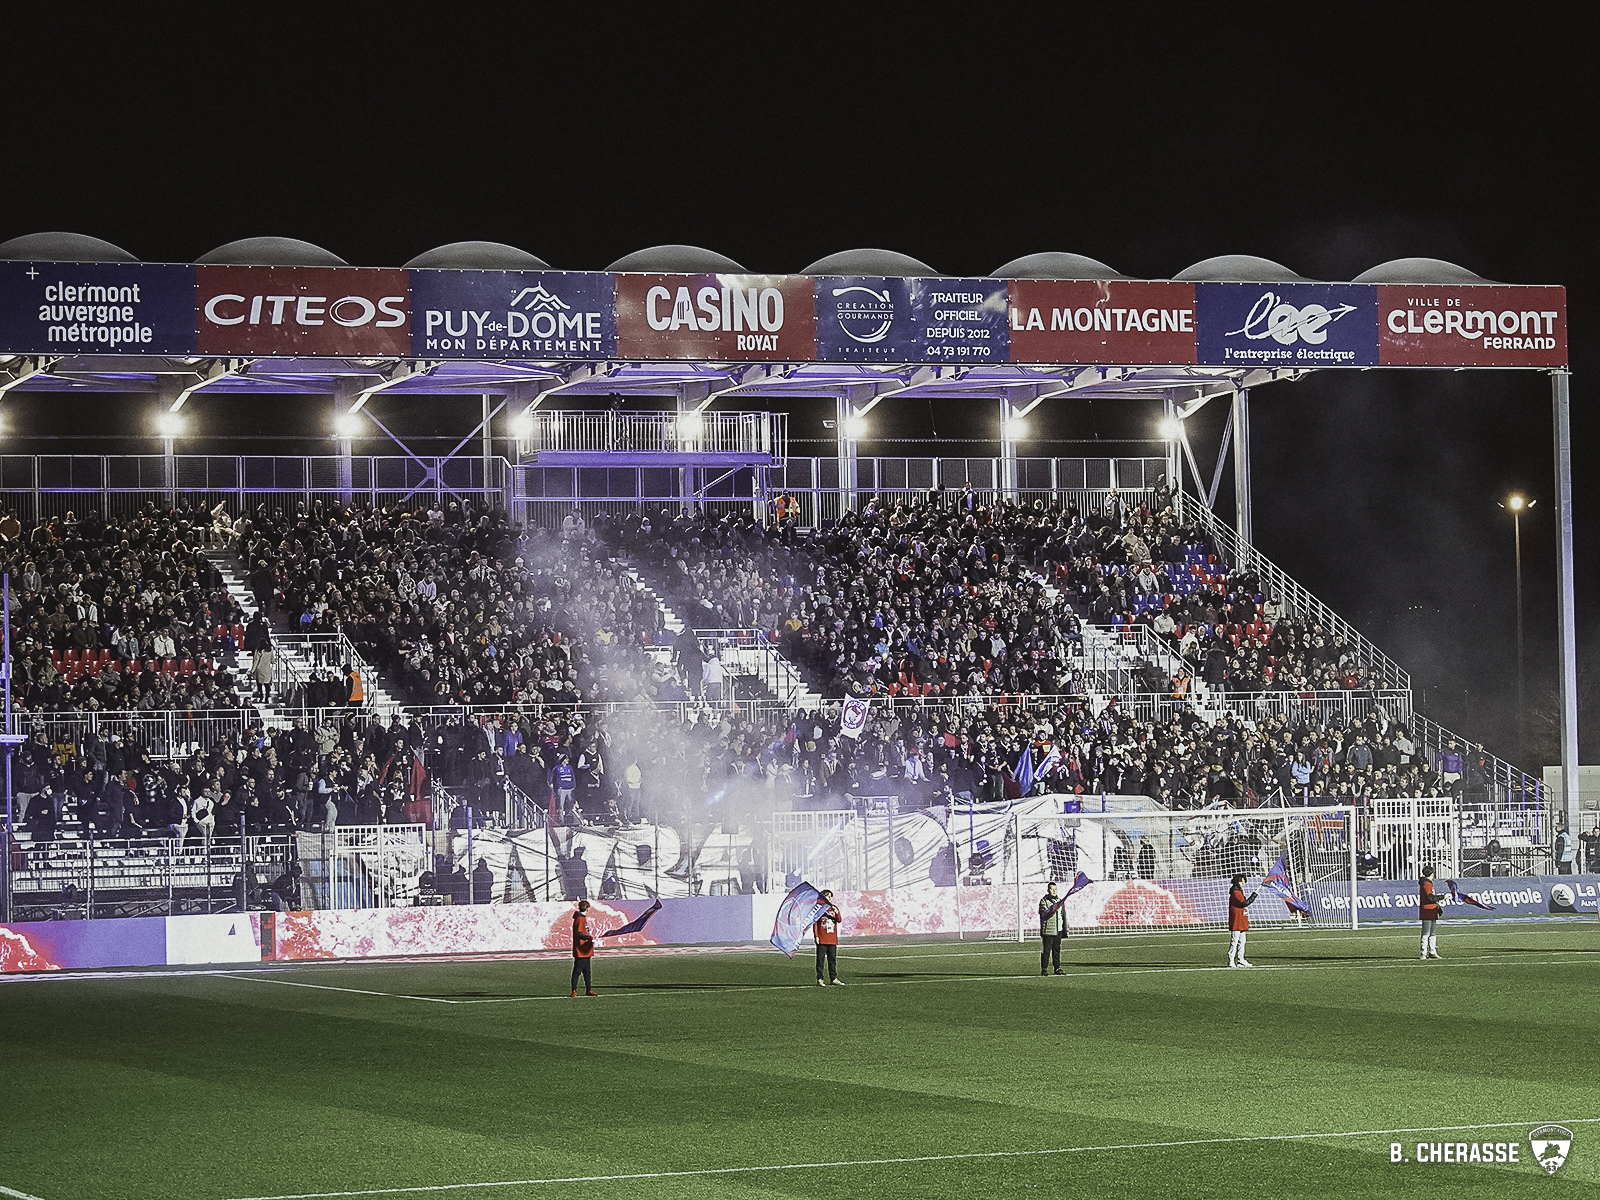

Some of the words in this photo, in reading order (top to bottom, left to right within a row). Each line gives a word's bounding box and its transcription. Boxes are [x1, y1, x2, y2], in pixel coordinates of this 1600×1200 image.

[45, 281, 141, 303] clermont
[931, 292, 984, 304] TRAITEUR
[646, 285, 785, 332] CASINO
[1407, 298, 1440, 307] VILLE
[1446, 298, 1461, 307] DE
[38, 304, 135, 324] auvergne
[204, 294, 406, 328] CITEOS
[837, 312, 894, 320] GOURMANDE
[934, 309, 982, 321] OFFICIEL
[1010, 306, 1046, 331] LA
[1050, 307, 1195, 333] MONTAGNE
[47, 322, 153, 348] métropole
[926, 327, 966, 339] DEPUIS
[966, 328, 991, 339] 2012
[426, 338, 467, 350] MON
[476, 336, 602, 351] DÉPARTEMENT
[737, 334, 779, 351] ROYAT
[926, 346, 942, 356] 04
[942, 346, 955, 356] 73
[956, 346, 971, 356] 191
[972, 346, 991, 356] 770
[1224, 347, 1293, 361] l'entreprise
[1296, 348, 1356, 361] électrique
[1575, 882, 1597, 897] La
